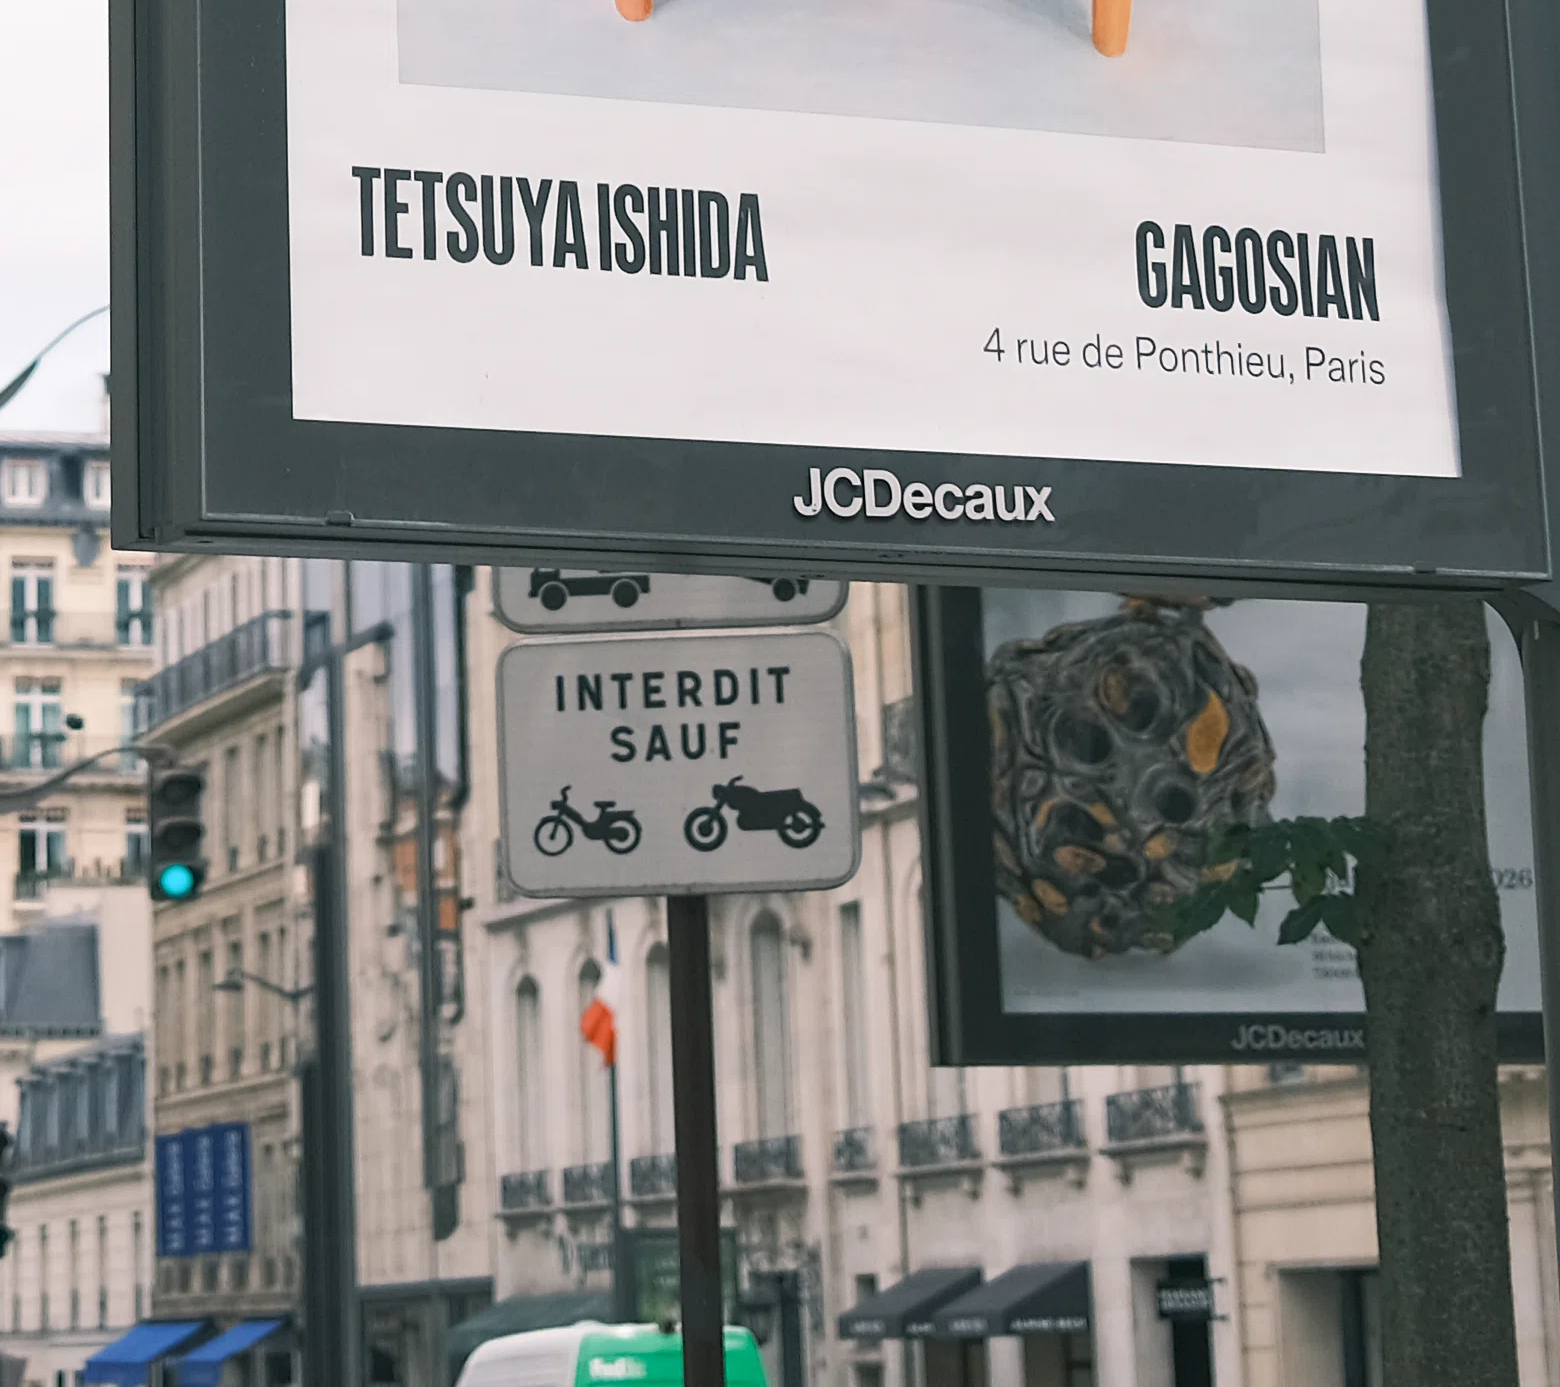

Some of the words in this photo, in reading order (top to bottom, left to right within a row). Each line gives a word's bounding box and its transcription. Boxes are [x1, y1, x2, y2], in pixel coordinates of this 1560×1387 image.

[351, 165, 589, 270] TETSUYA
[596, 182, 769, 283] ISHIDA
[1135, 220, 1382, 322] GAGOSIAN
[983, 327, 1006, 362] 4
[1015, 338, 1071, 367] rue
[1082, 333, 1124, 369] de
[1135, 336, 1296, 385] Ponthieu,
[1305, 346, 1386, 385] Paris
[793, 467, 1056, 522] JCDecaux
[556, 666, 791, 712] INTERDIT
[610, 721, 741, 763] SAUF
[1498, 868, 1534, 890] 026
[1231, 1023, 1365, 1050] JCDecaux
